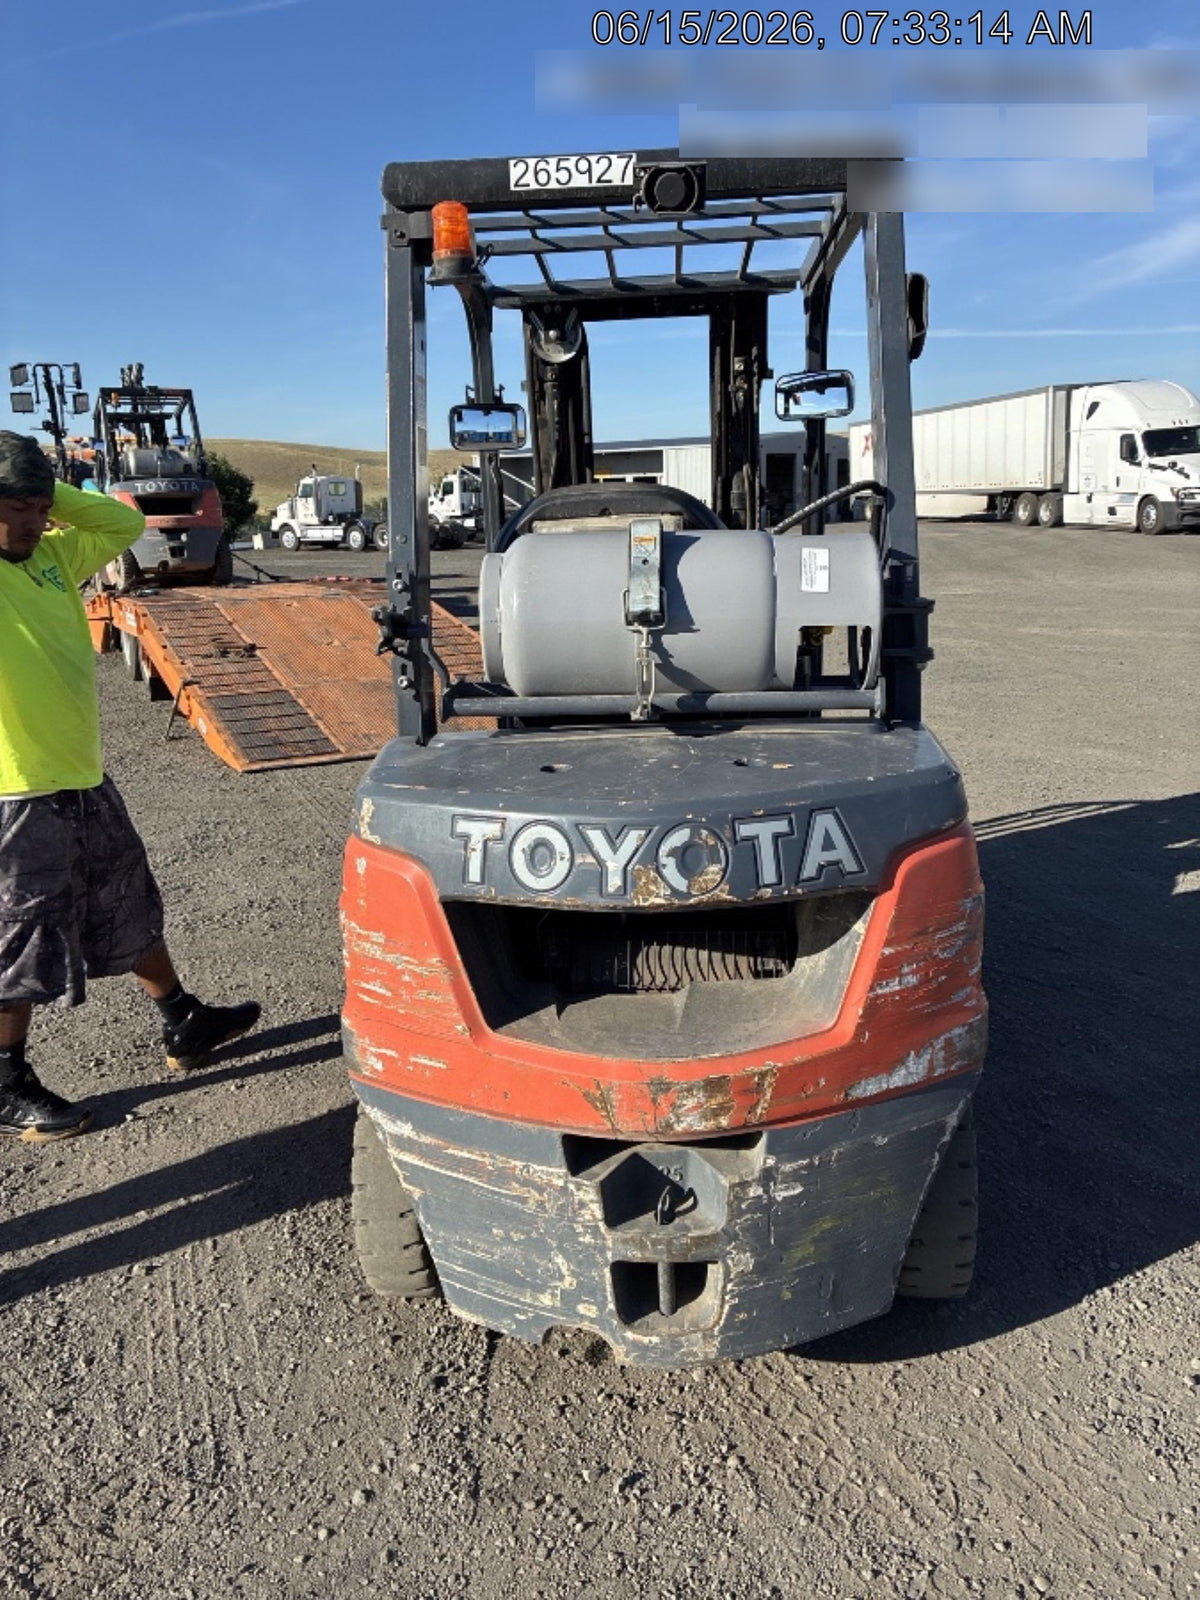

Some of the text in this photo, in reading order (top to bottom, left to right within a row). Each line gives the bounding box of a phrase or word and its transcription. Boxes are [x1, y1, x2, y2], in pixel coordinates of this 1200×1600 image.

[513, 154, 634, 188] 265927
[134, 481, 200, 494] TOYOTA
[451, 806, 867, 899] TOYOTA
